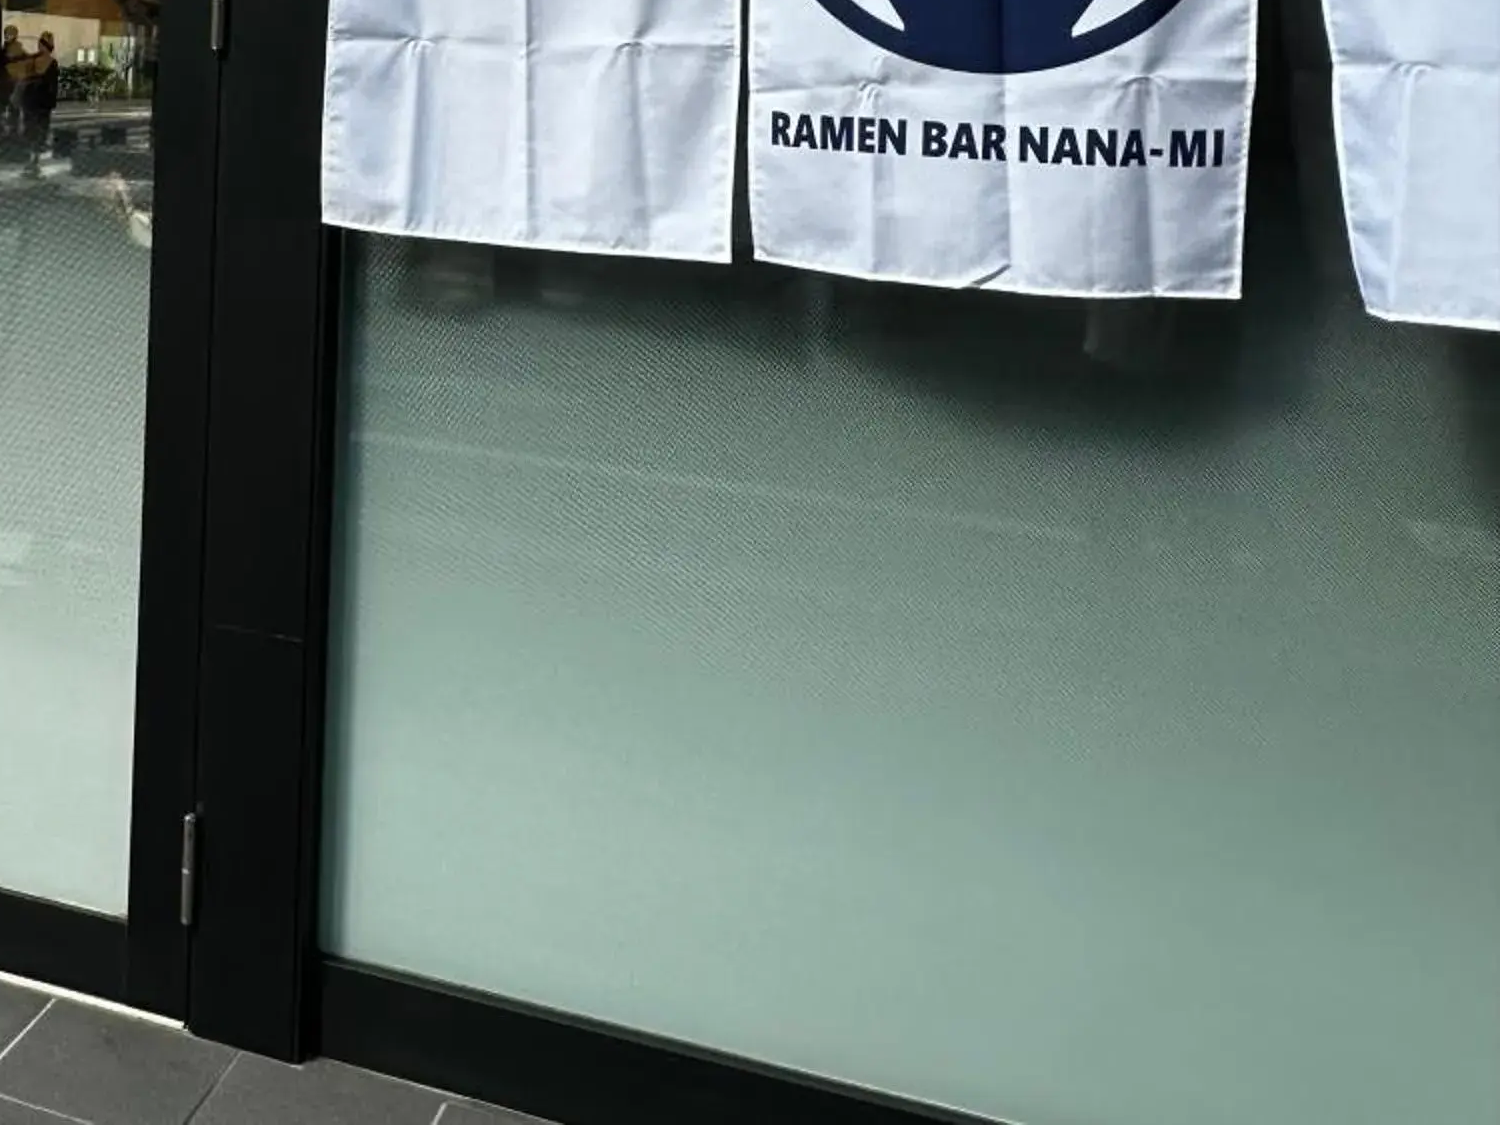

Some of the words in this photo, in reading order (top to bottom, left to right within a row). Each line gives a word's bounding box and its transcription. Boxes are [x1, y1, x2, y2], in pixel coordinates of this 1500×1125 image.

[771, 111, 907, 156] RAMEN
[921, 120, 1007, 162] BAR
[1019, 126, 1225, 168] NANA-MI
